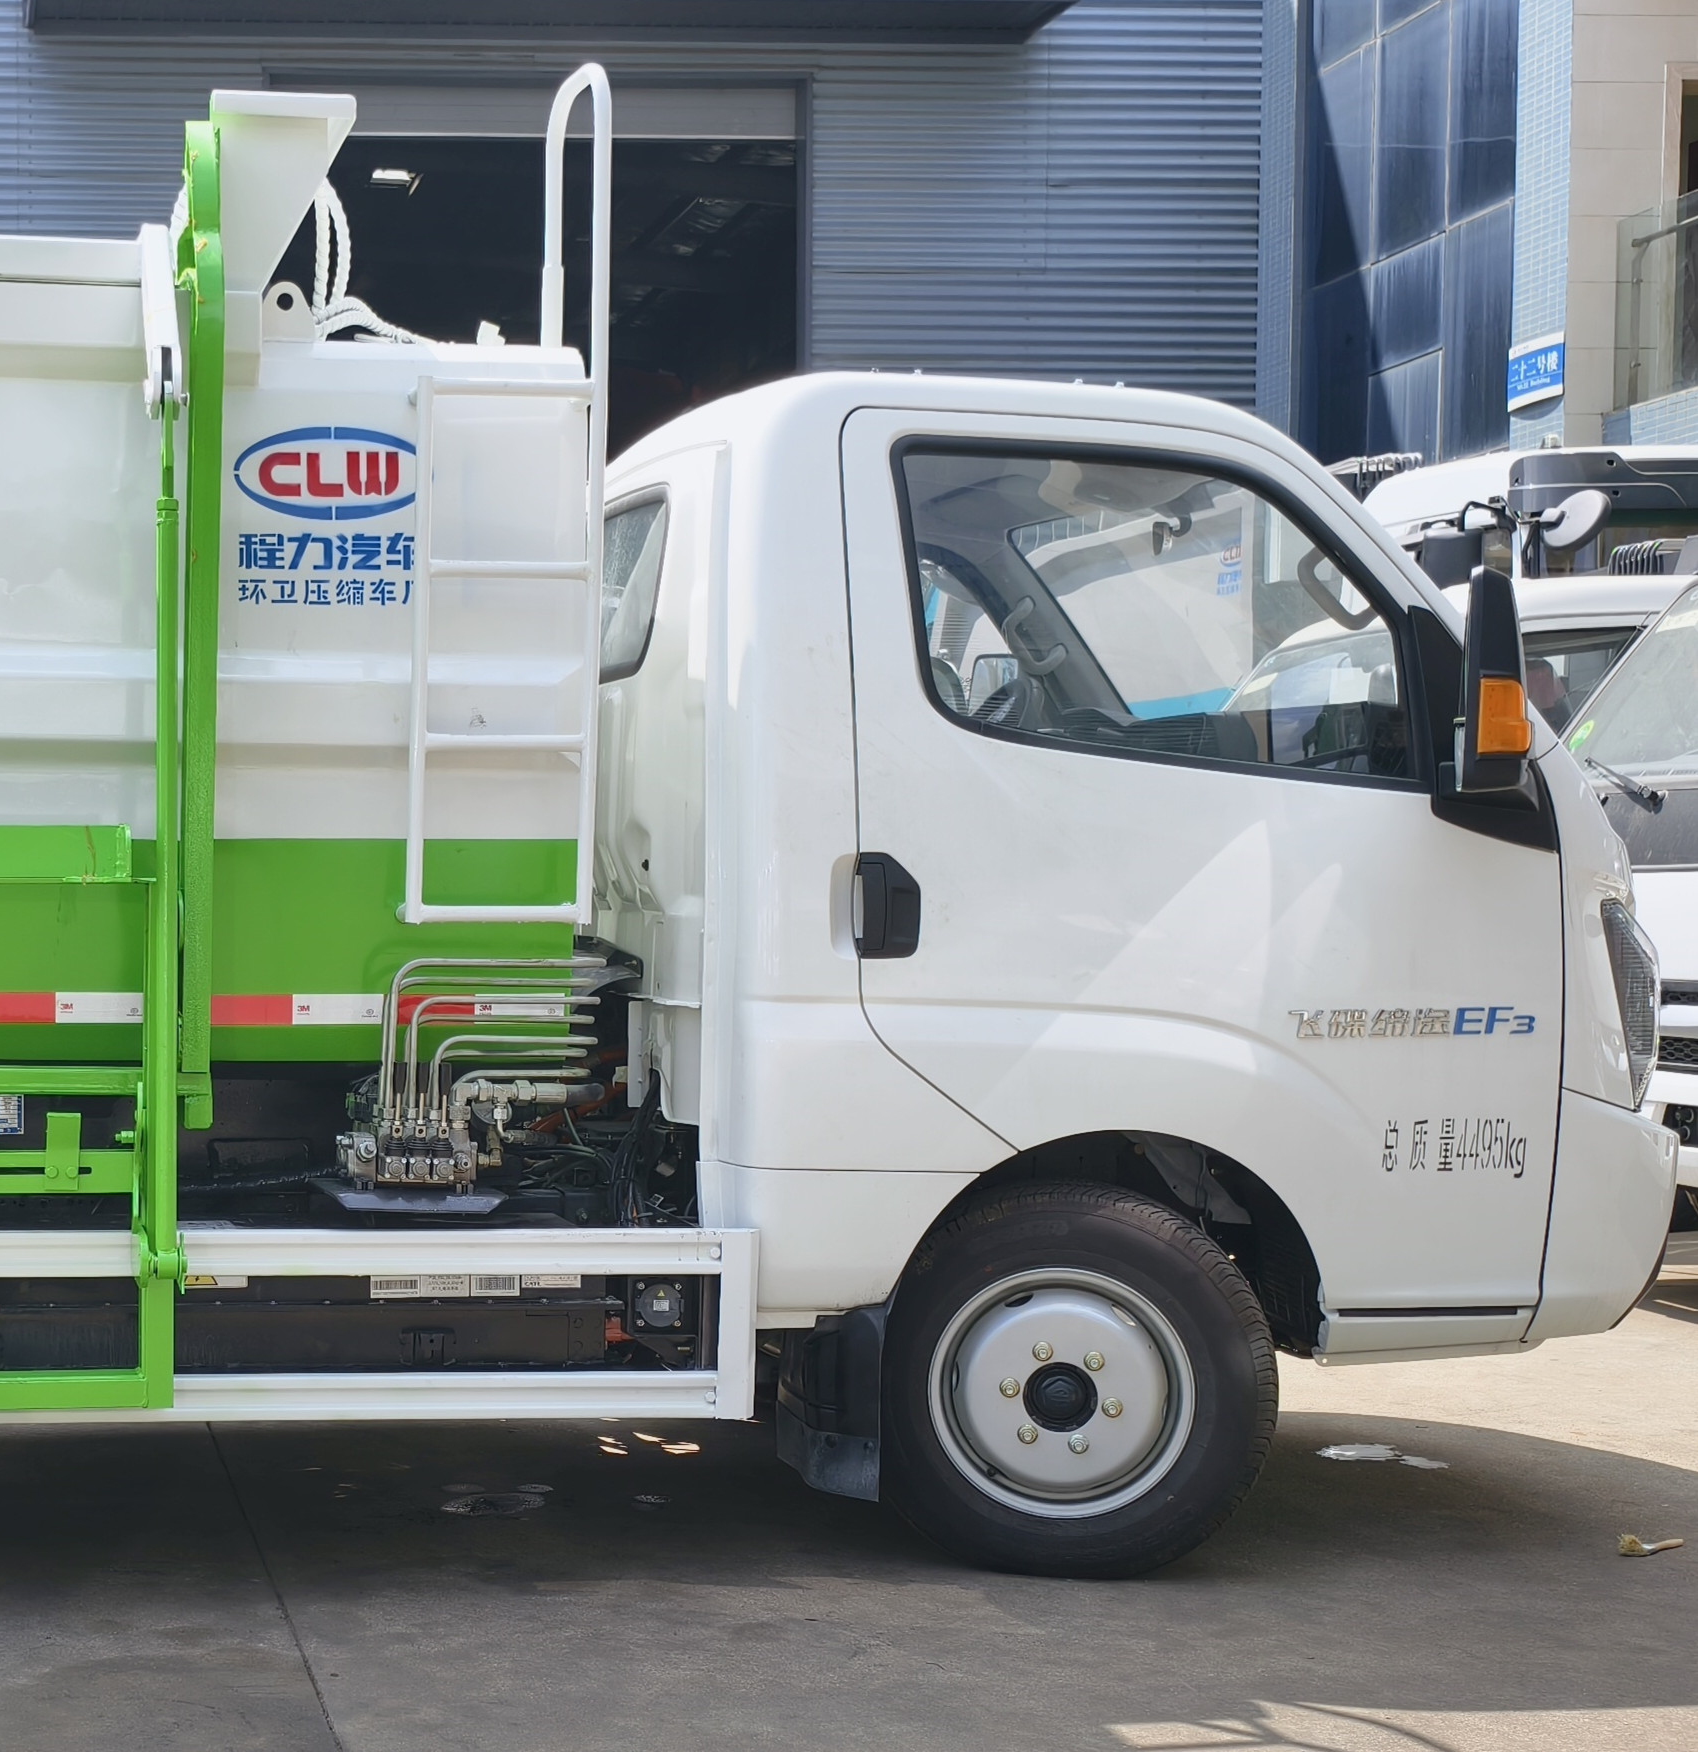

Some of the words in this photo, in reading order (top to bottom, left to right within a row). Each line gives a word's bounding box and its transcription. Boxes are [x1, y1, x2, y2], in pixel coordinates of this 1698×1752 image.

[258, 451, 400, 497] CLW
[238, 533, 415, 571] 程力汽车
[297, 1004, 311, 1013] 3M
[479, 1004, 493, 1012] 3M
